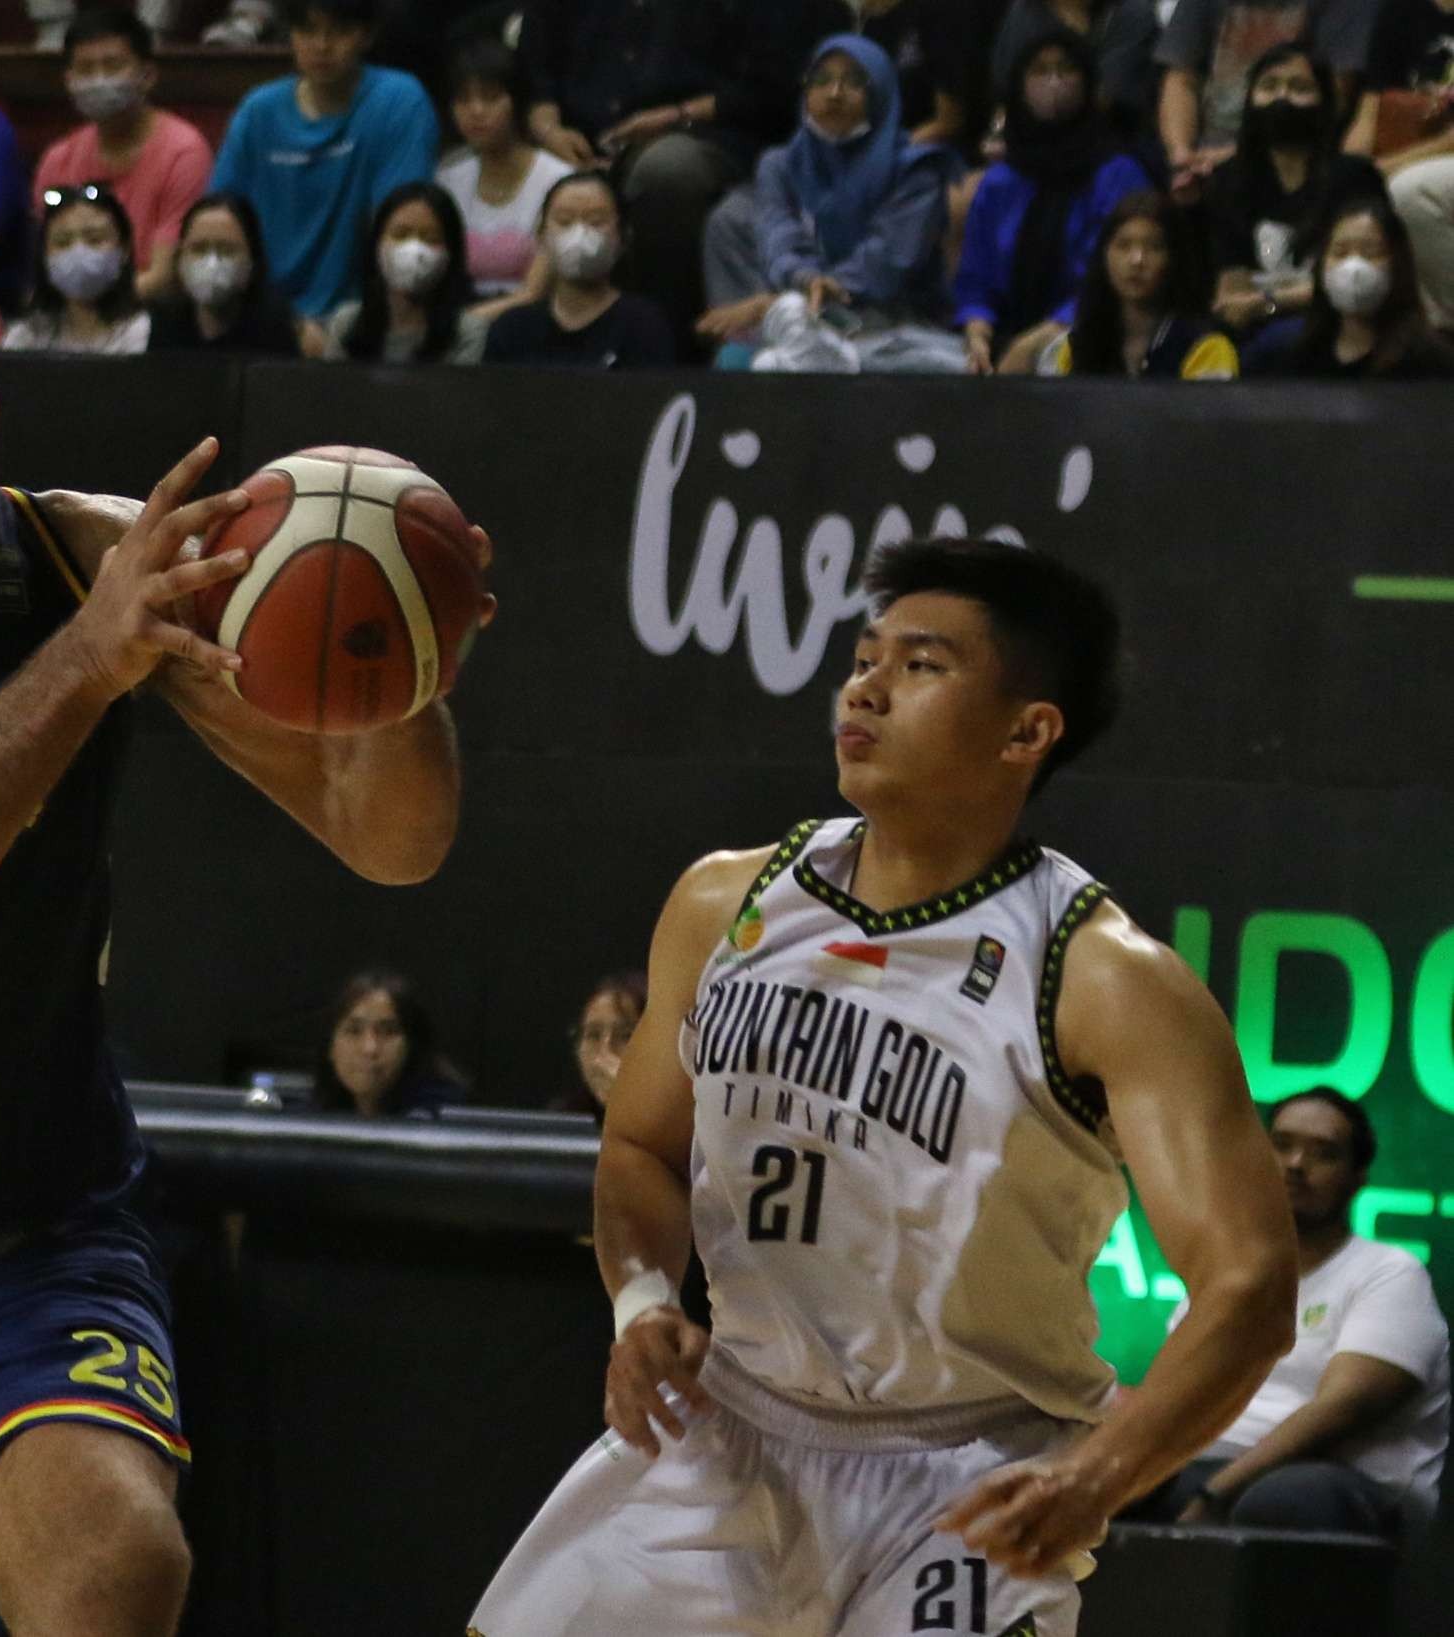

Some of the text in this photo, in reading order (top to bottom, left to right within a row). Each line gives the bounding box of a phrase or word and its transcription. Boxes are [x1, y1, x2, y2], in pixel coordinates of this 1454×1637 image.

[686, 980, 967, 1167] OUNTAIN GOLD
[724, 1081, 868, 1151] TIMIKA
[748, 1144, 827, 1245] 21
[68, 1329, 175, 1419] 25
[911, 1556, 987, 1634] 21
